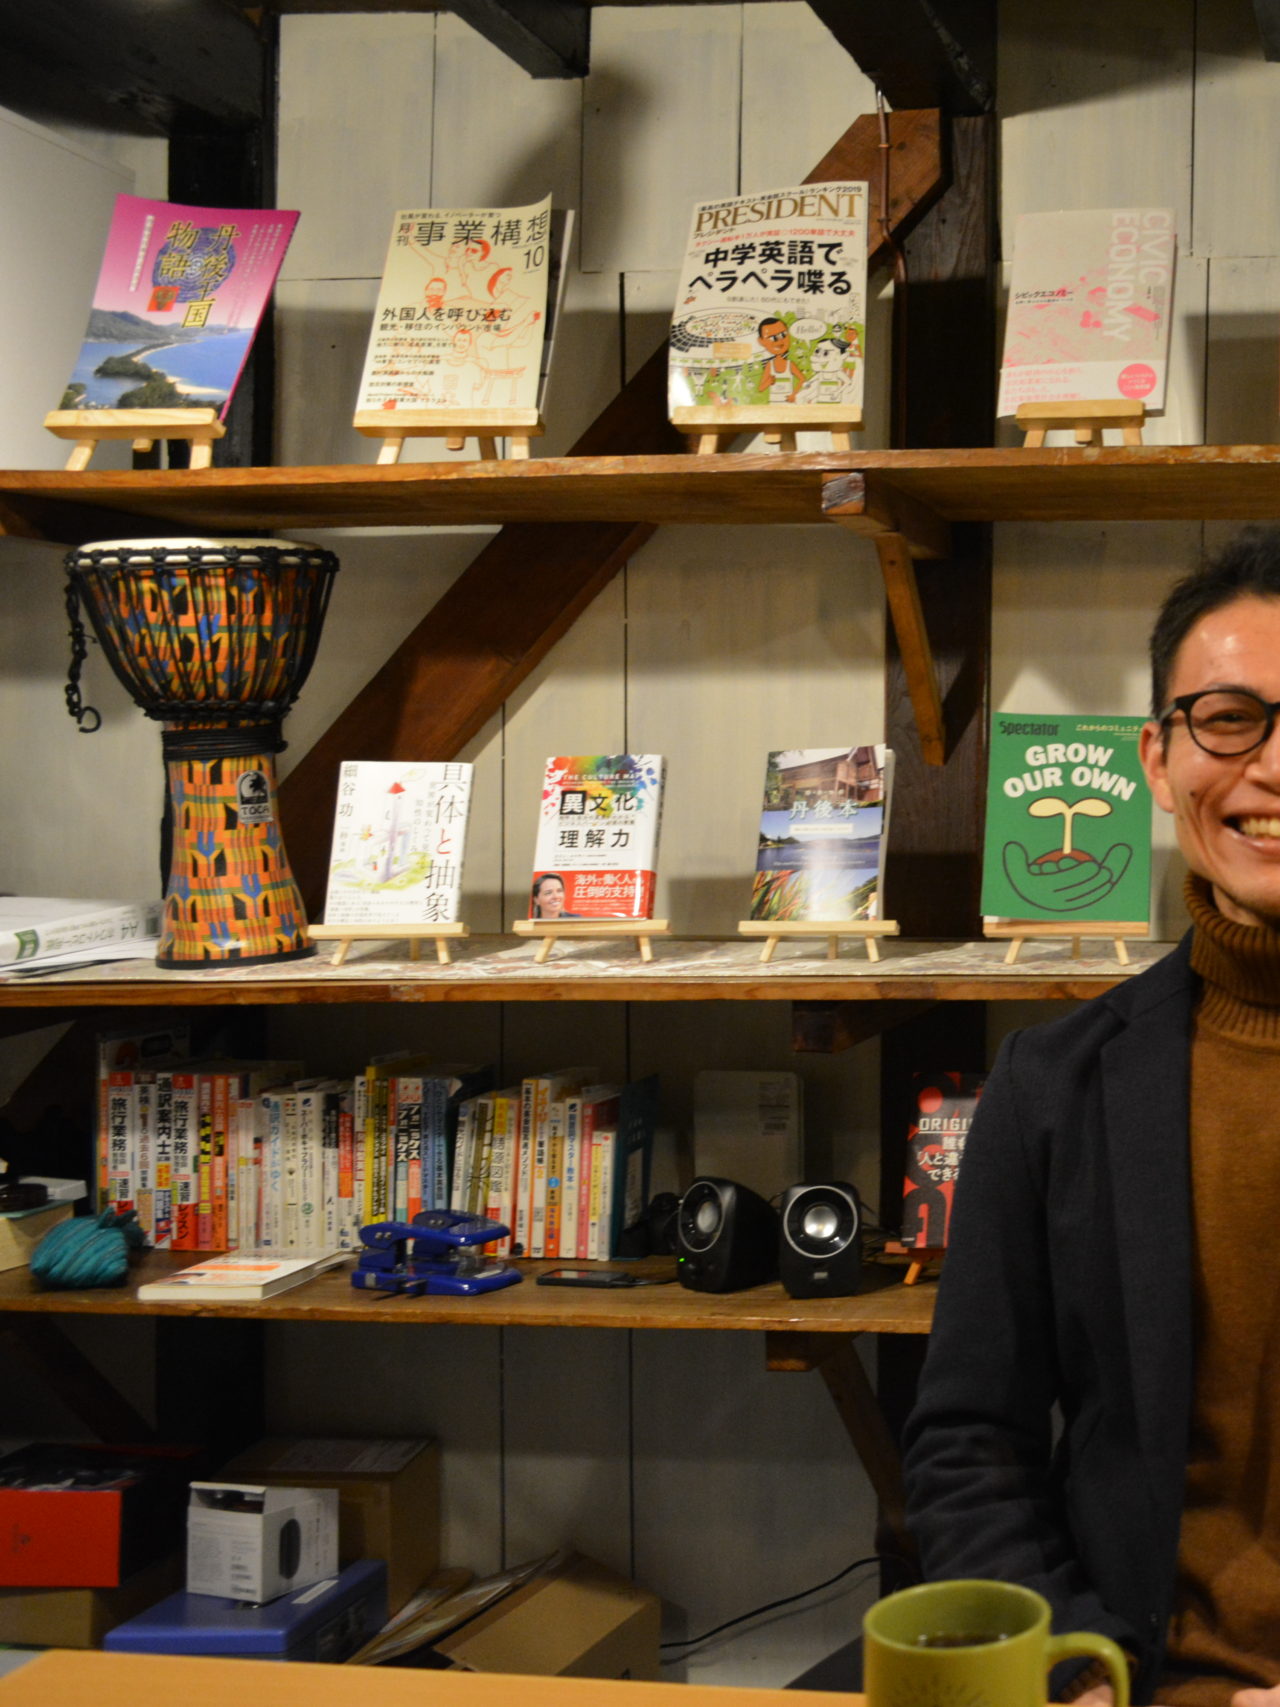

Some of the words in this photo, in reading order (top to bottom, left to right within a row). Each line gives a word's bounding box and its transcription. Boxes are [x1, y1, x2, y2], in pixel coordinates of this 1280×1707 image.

[695, 193, 864, 232] PRESIDENT
[413, 209, 549, 247] 事業構想
[160, 221, 200, 280] 物語
[523, 245, 545, 269] 10
[704, 240, 844, 269] 中学英語で
[1138, 211, 1171, 287] CIVIC
[687, 267, 853, 296] ペラペラ喋る
[1102, 212, 1141, 342] ECONOMY
[381, 307, 513, 322] 外国人を呼び込む
[999, 720, 1061, 736] Spectator
[1024, 742, 1115, 768] GROW
[1002, 766, 1063, 799] OUR
[1070, 765, 1138, 802] OWN
[240, 804, 271, 816] TOCA
[559, 790, 637, 816] 異文化
[788, 799, 859, 820] 丹後本
[423, 763, 468, 922] 具体と抽象
[558, 828, 630, 849] 理解力
[111, 1096, 128, 1152] 旅行業務
[156, 1077, 173, 1155] 通訳案内士
[173, 1100, 190, 1155] 旅行業務
[918, 1117, 974, 1131] ORIGI
